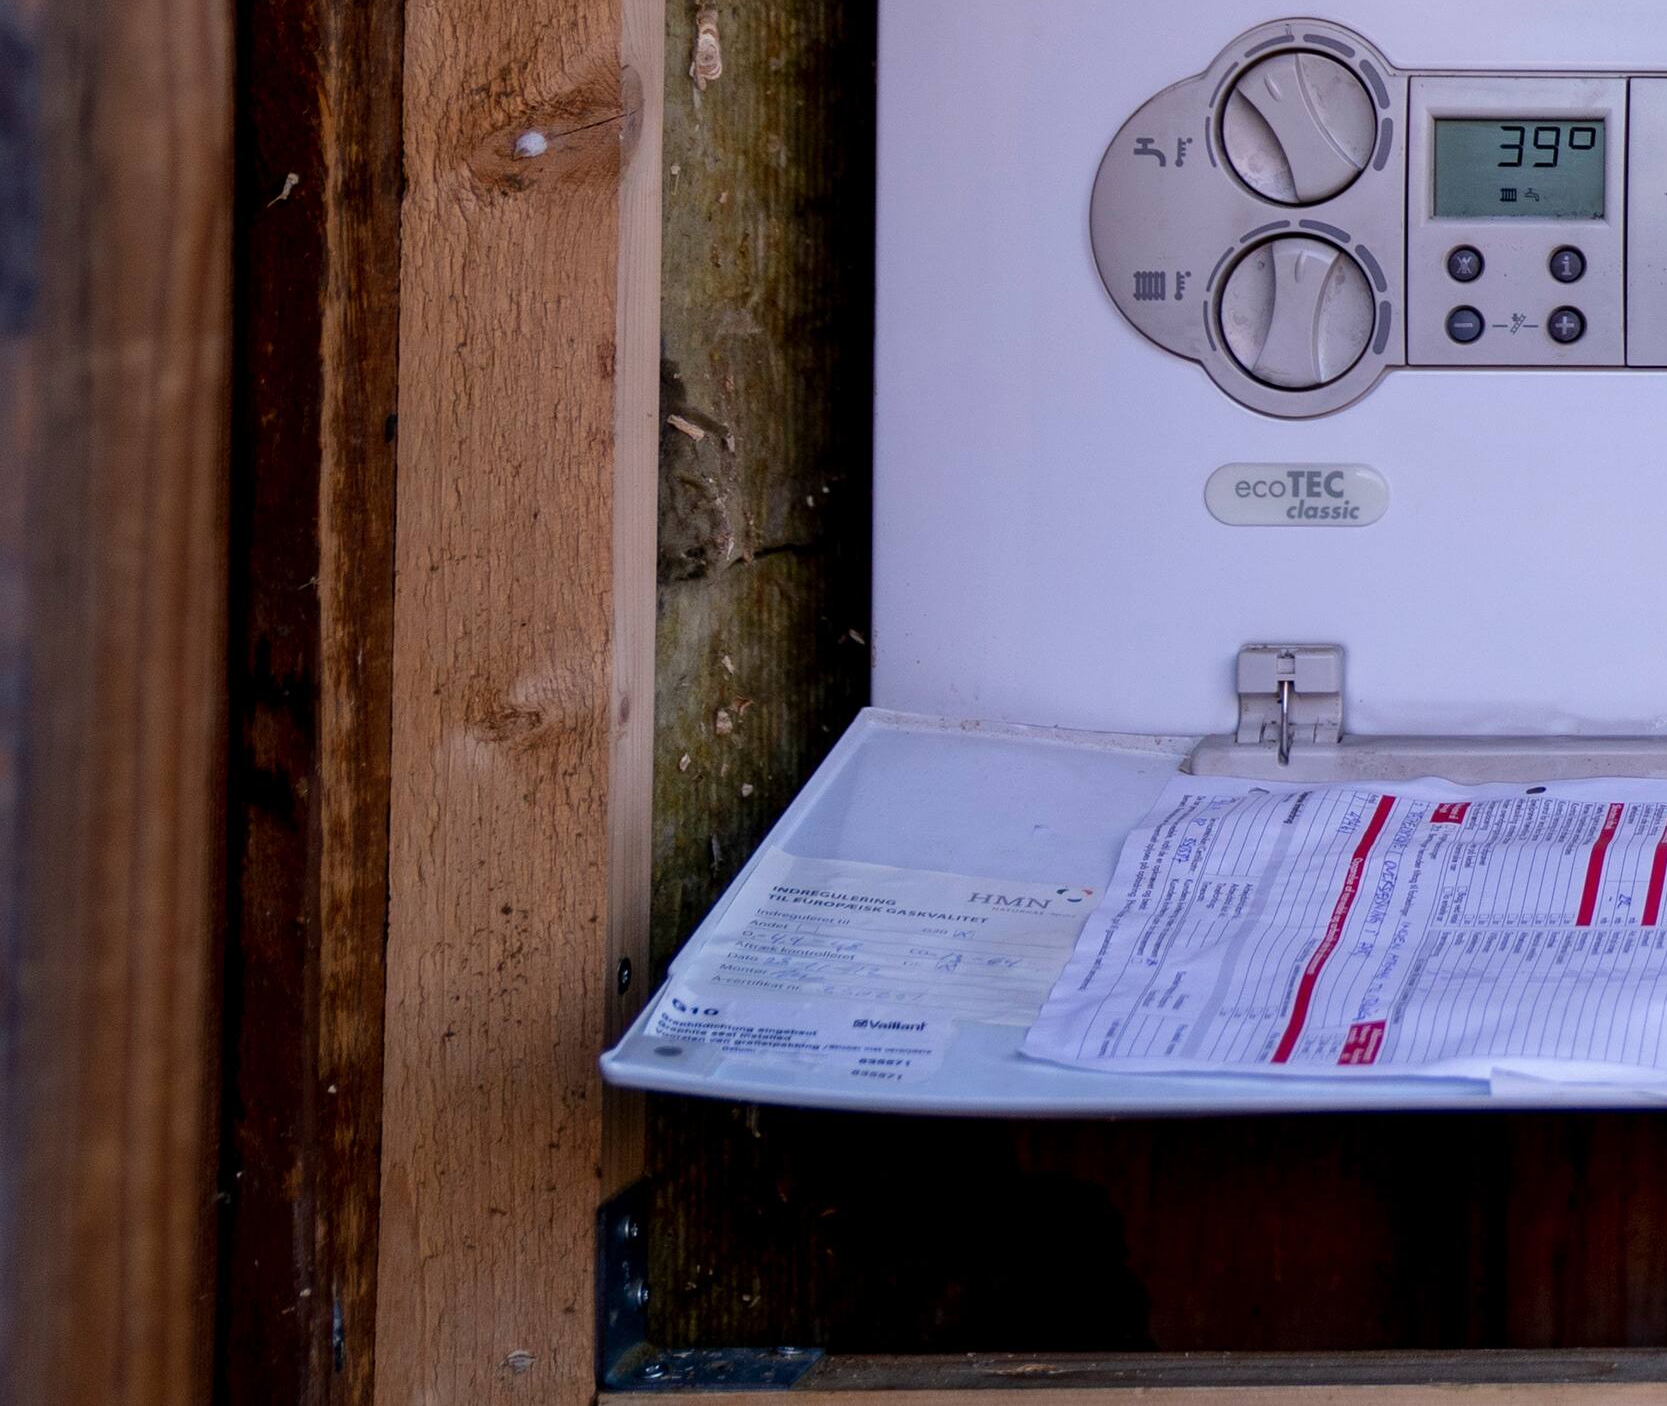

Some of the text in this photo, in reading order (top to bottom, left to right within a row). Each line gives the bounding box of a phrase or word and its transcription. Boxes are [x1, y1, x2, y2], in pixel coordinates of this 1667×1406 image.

[1235, 469, 1345, 499] ecoTEC
[1286, 499, 1360, 520] classic
[772, 885, 897, 905] INDREGULERING
[968, 893, 1053, 909] HMN
[768, 893, 989, 924] TIL EUROPÆISK GASKVALITET
[672, 997, 719, 1016] G10
[869, 1020, 928, 1032] Vaillant
